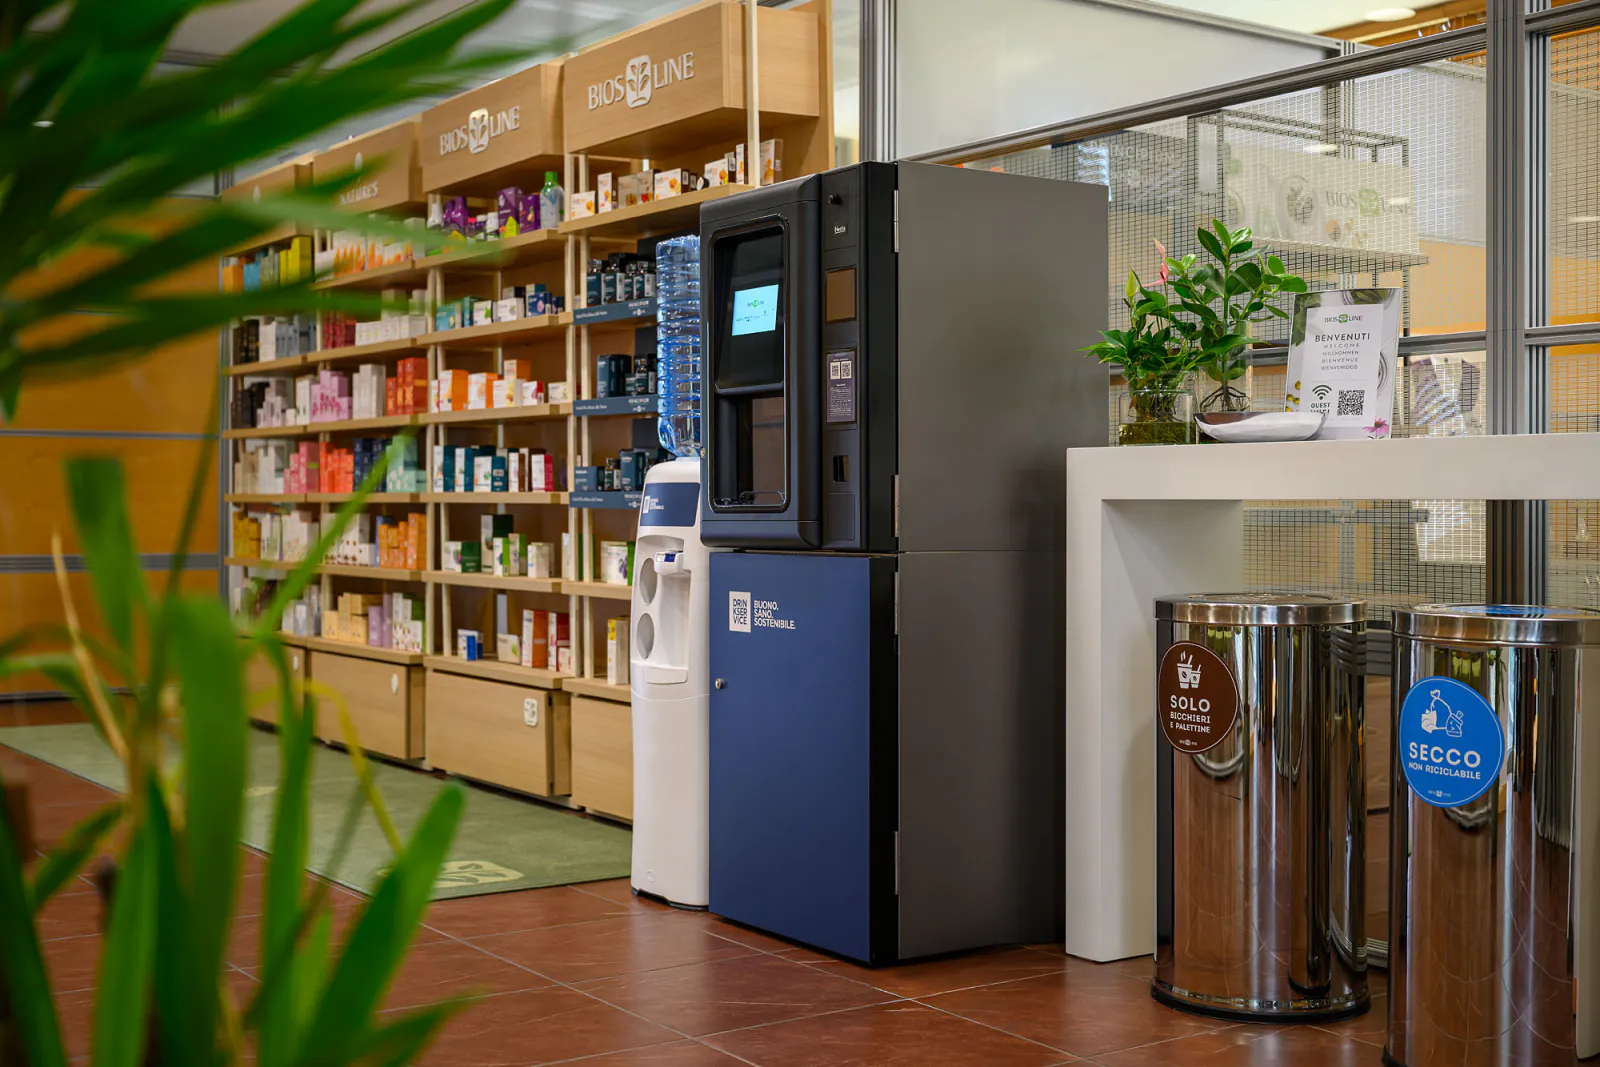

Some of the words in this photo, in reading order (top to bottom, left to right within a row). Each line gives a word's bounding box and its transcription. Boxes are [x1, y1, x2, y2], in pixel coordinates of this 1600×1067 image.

[588, 75, 625, 110] BIOS
[653, 51, 694, 89] LINE
[440, 124, 468, 156] BIOS
[489, 105, 520, 137] LINE
[1315, 332, 1371, 343] BENVENUTI
[732, 598, 748, 608] DRIN
[753, 599, 779, 611] BUONO.
[732, 607, 748, 617] KSER
[753, 608, 774, 619] SANO.
[732, 615, 748, 625] VICE
[753, 617, 796, 630] SOSTENIBILE.
[1170, 694, 1211, 713] SOLO
[1170, 711, 1211, 724] BICCHIERI
[1170, 721, 1174, 729] E
[1175, 722, 1211, 734] PALETTINE
[1409, 741, 1481, 768] SECCO
[1408, 761, 1423, 771] NON
[1425, 764, 1481, 780] RICICLABILE
